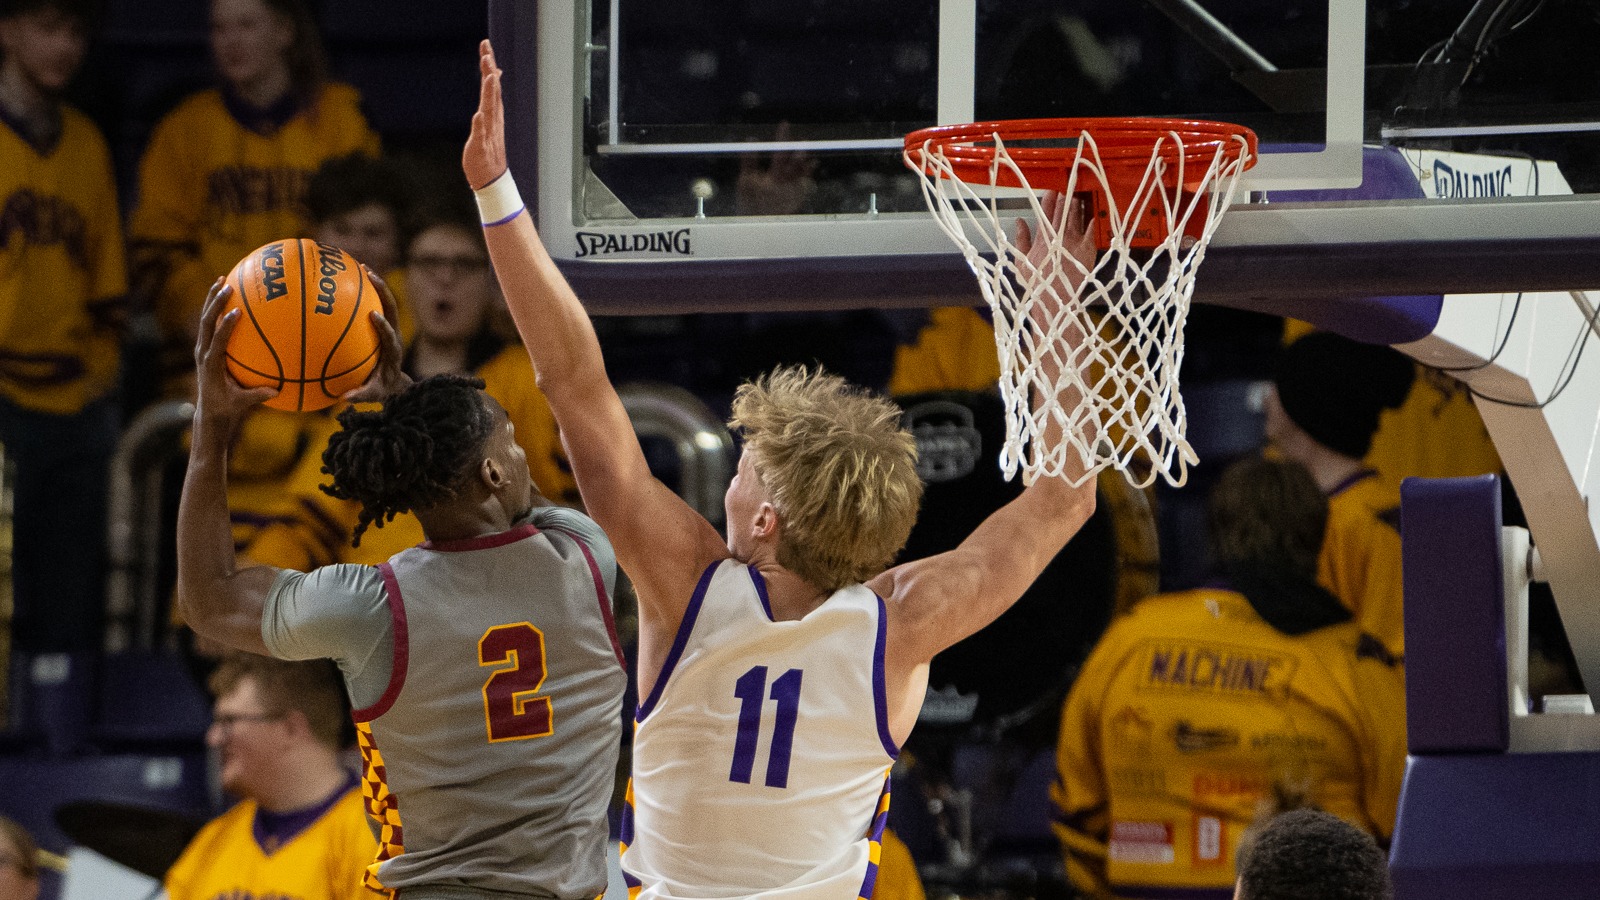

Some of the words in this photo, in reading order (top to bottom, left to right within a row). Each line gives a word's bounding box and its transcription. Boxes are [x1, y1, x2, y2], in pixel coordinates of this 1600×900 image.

[261, 243, 289, 302] NCAA
[575, 228, 691, 258] SPALDING
[478, 621, 554, 743] 2
[729, 665, 803, 788] 11
